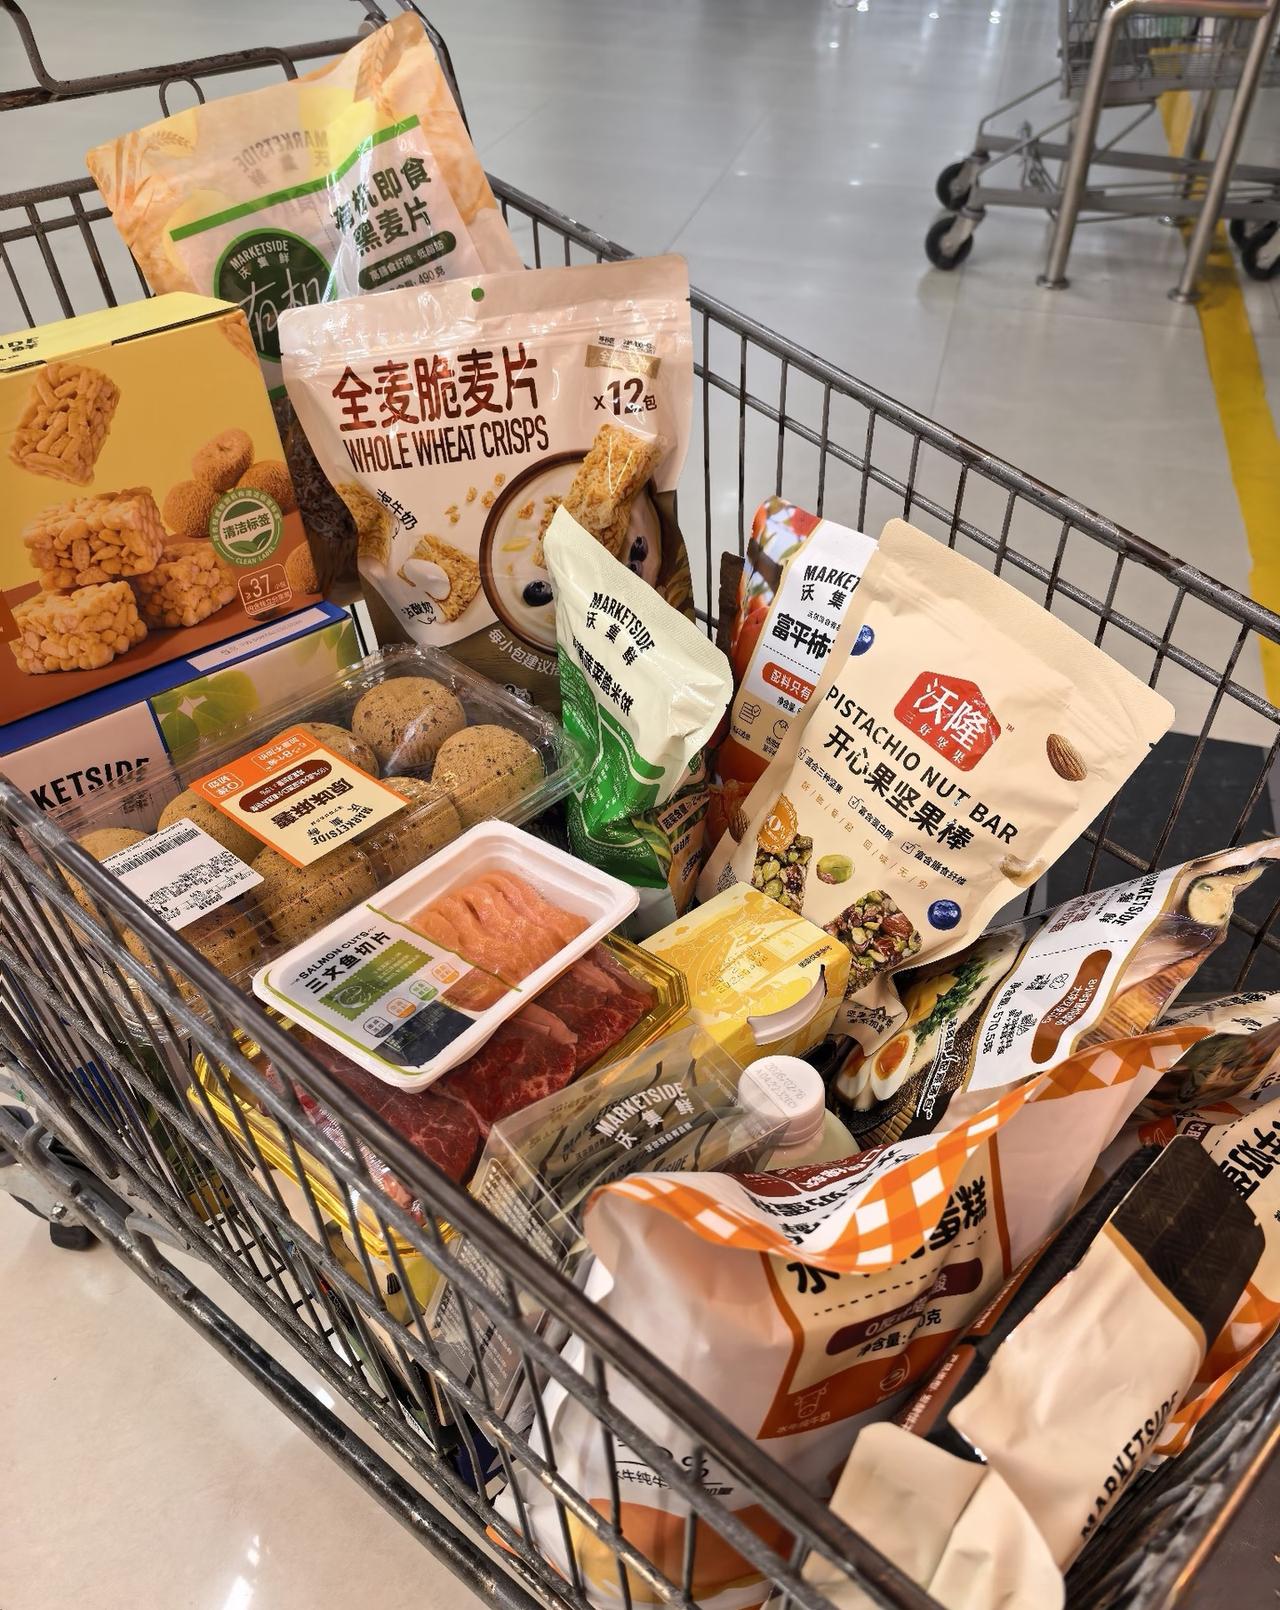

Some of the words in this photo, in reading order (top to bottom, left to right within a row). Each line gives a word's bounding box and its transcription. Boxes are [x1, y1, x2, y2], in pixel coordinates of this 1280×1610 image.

[334, 156, 431, 230] 有机即食
[353, 196, 432, 257] 黑麦片
[229, 240, 289, 269] MARKETSIDE
[332, 342, 539, 432] 全麦脆麦片
[343, 432, 414, 473] WHOLE
[411, 423, 475, 466] WHEAT
[480, 415, 549, 458] CRISPS
[222, 512, 271, 539] 清洁标签
[585, 611, 638, 666] 沃集鲜
[589, 591, 656, 653] MARKETSIDE
[772, 613, 836, 660] 富平柿
[769, 668, 813, 701] 配料只有
[902, 711, 966, 765] 三好坚果
[912, 677, 989, 752] 沃隆
[804, 756, 844, 794] 混合三种坚果
[823, 724, 976, 852] 开心果坚果棒
[825, 685, 921, 770] PISTACHIO
[920, 765, 972, 806] NUT
[969, 801, 1019, 845] BAR
[270, 777, 354, 830] 原味麻薯
[310, 806, 374, 846] MARKETSIDE
[857, 805, 895, 841] 富含蛋白质
[913, 849, 968, 886] 富含膳食纤维
[299, 948, 342, 979] SALMON
[341, 931, 369, 950] CUTS
[304, 931, 391, 994] 三文鱼切片
[595, 1081, 688, 1138] MARKETSIDE
[614, 1097, 695, 1150] 沃集鲜
[1218, 1119, 1280, 1201] 牛奶蛋
[615, 1468, 673, 1490] 牛纯牛
